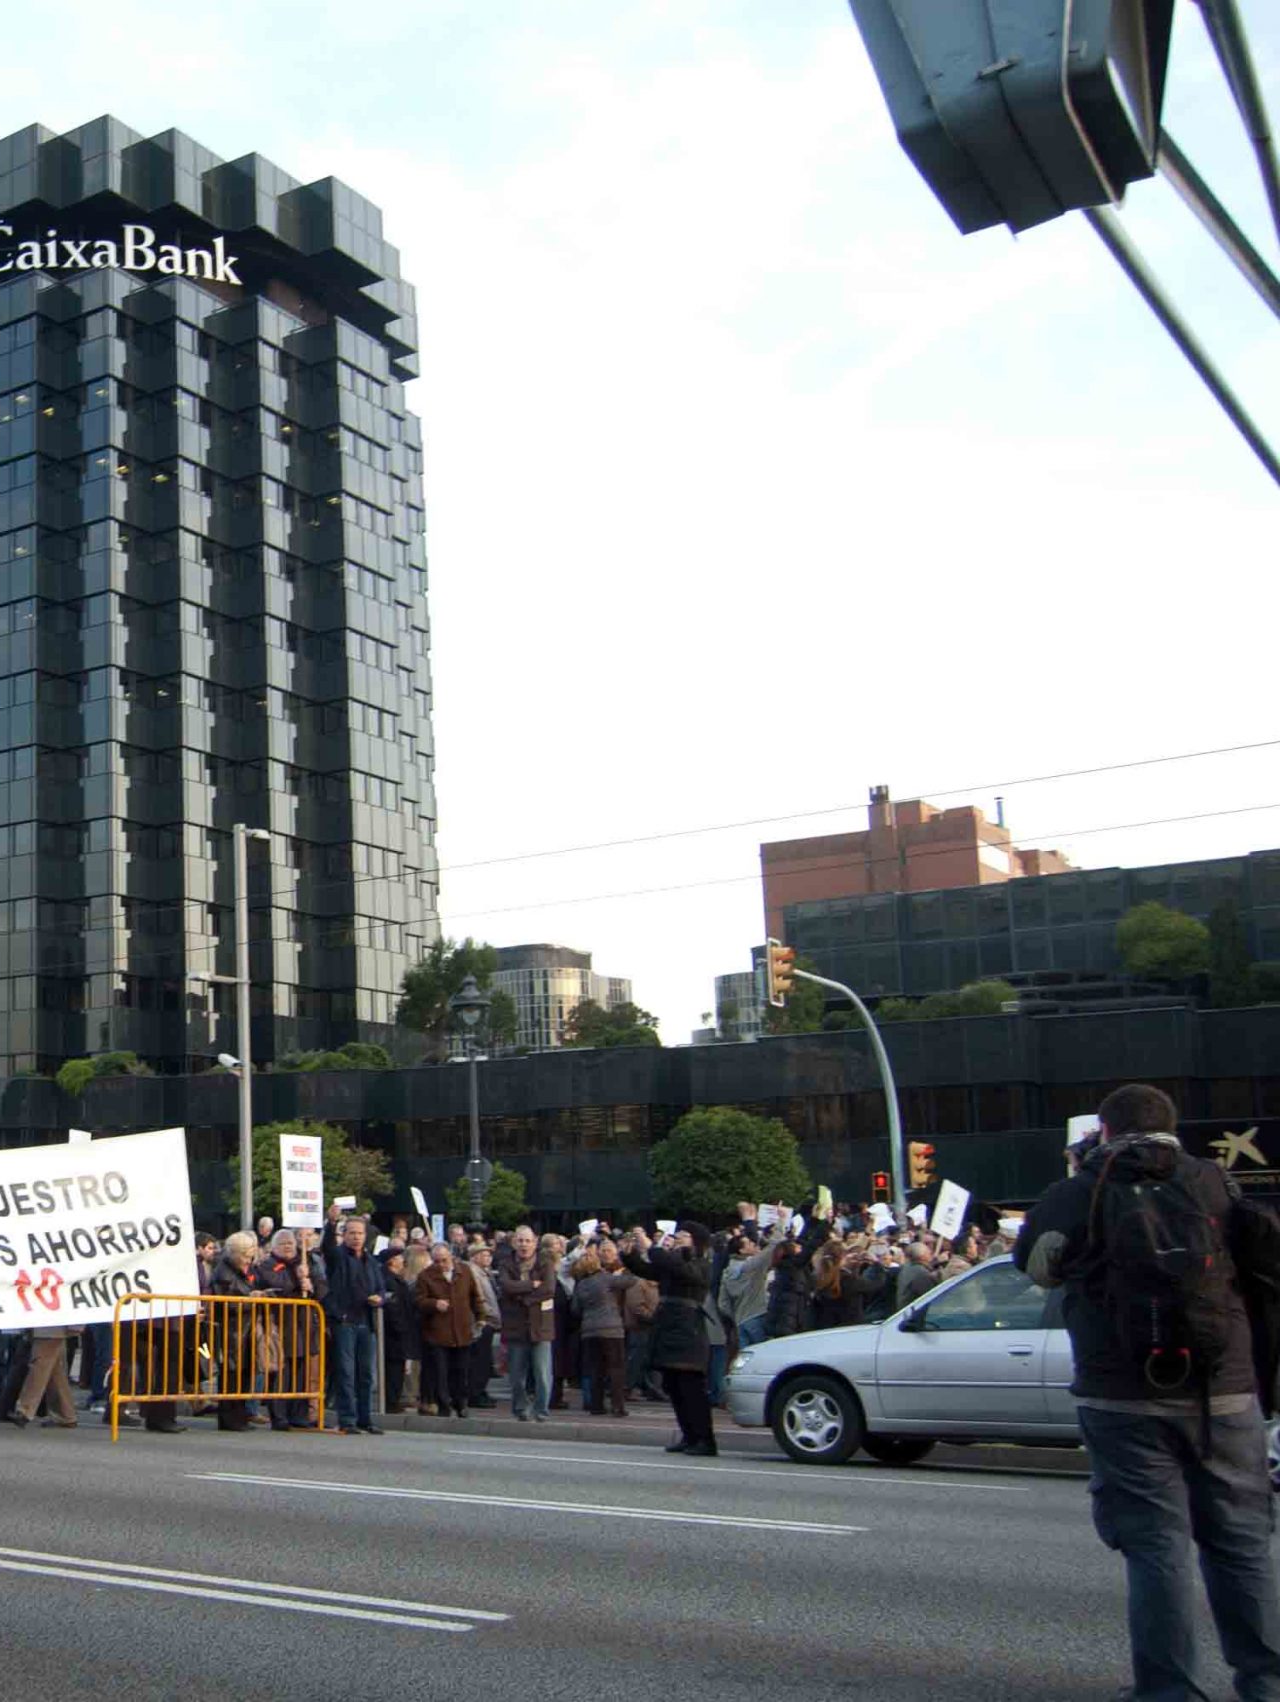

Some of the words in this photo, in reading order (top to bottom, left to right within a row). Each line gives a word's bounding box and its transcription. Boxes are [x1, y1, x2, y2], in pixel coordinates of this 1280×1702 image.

[27, 1213, 183, 1265] AHORROS
[13, 1267, 65, 1312] 10
[70, 1268, 153, 1310] AÑOS
